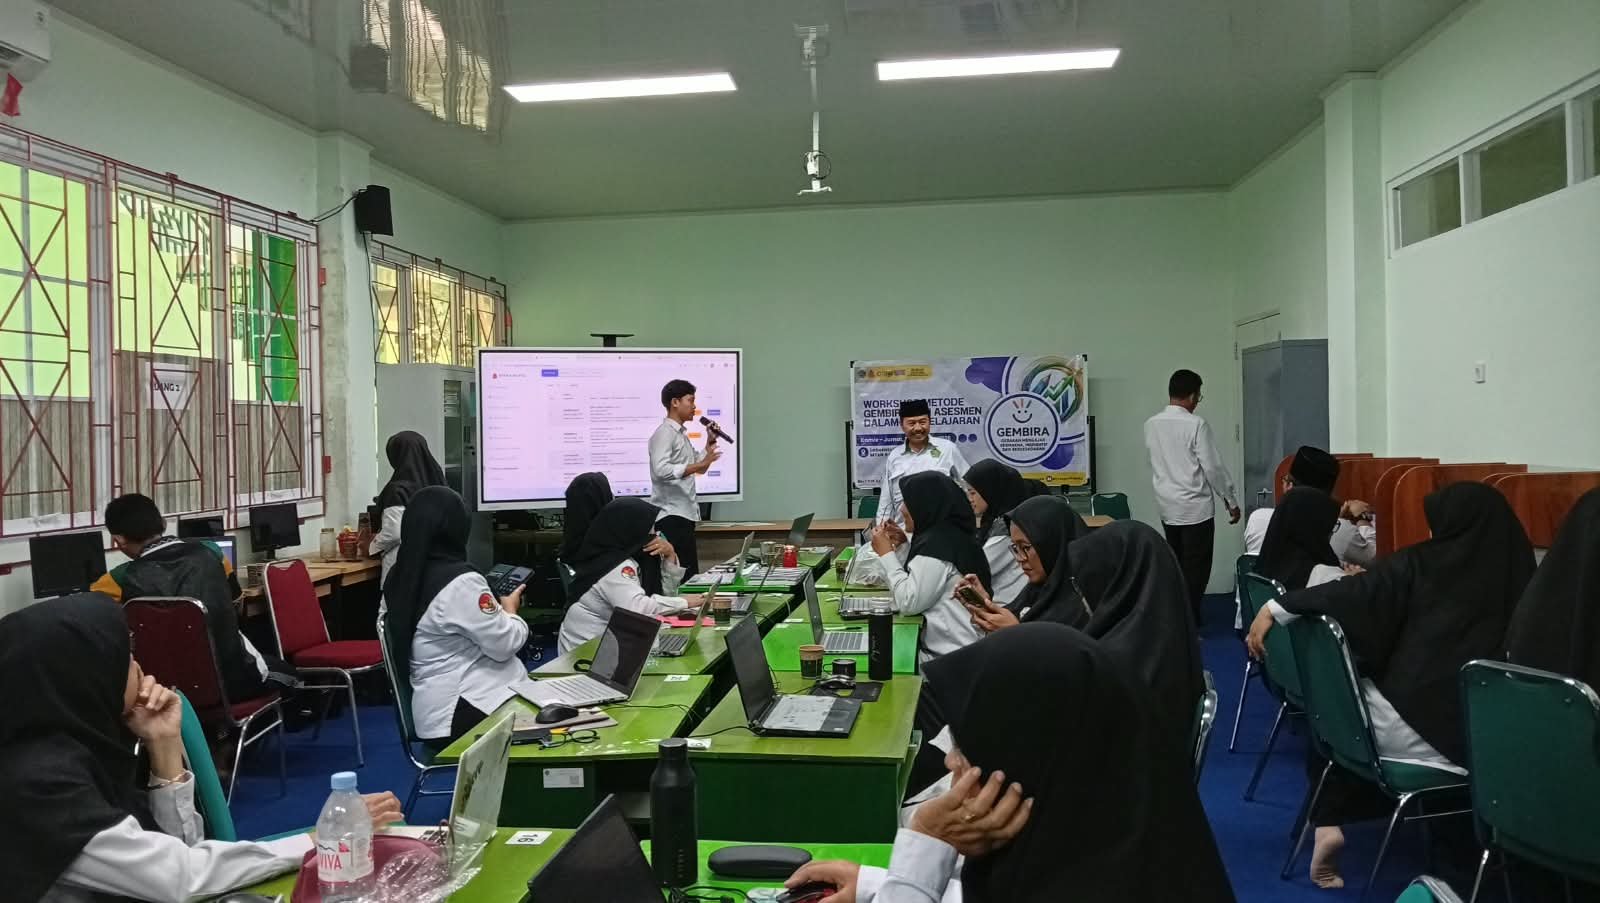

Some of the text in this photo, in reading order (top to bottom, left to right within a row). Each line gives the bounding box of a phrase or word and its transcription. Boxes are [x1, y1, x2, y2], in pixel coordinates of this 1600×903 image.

[864, 399, 915, 409] WORKS
[864, 409, 900, 418] GEMBIR
[934, 407, 982, 417] ASESMEN
[864, 416, 981, 427] DALAM ELAJARAN
[997, 427, 1050, 437] GEMBIRA
